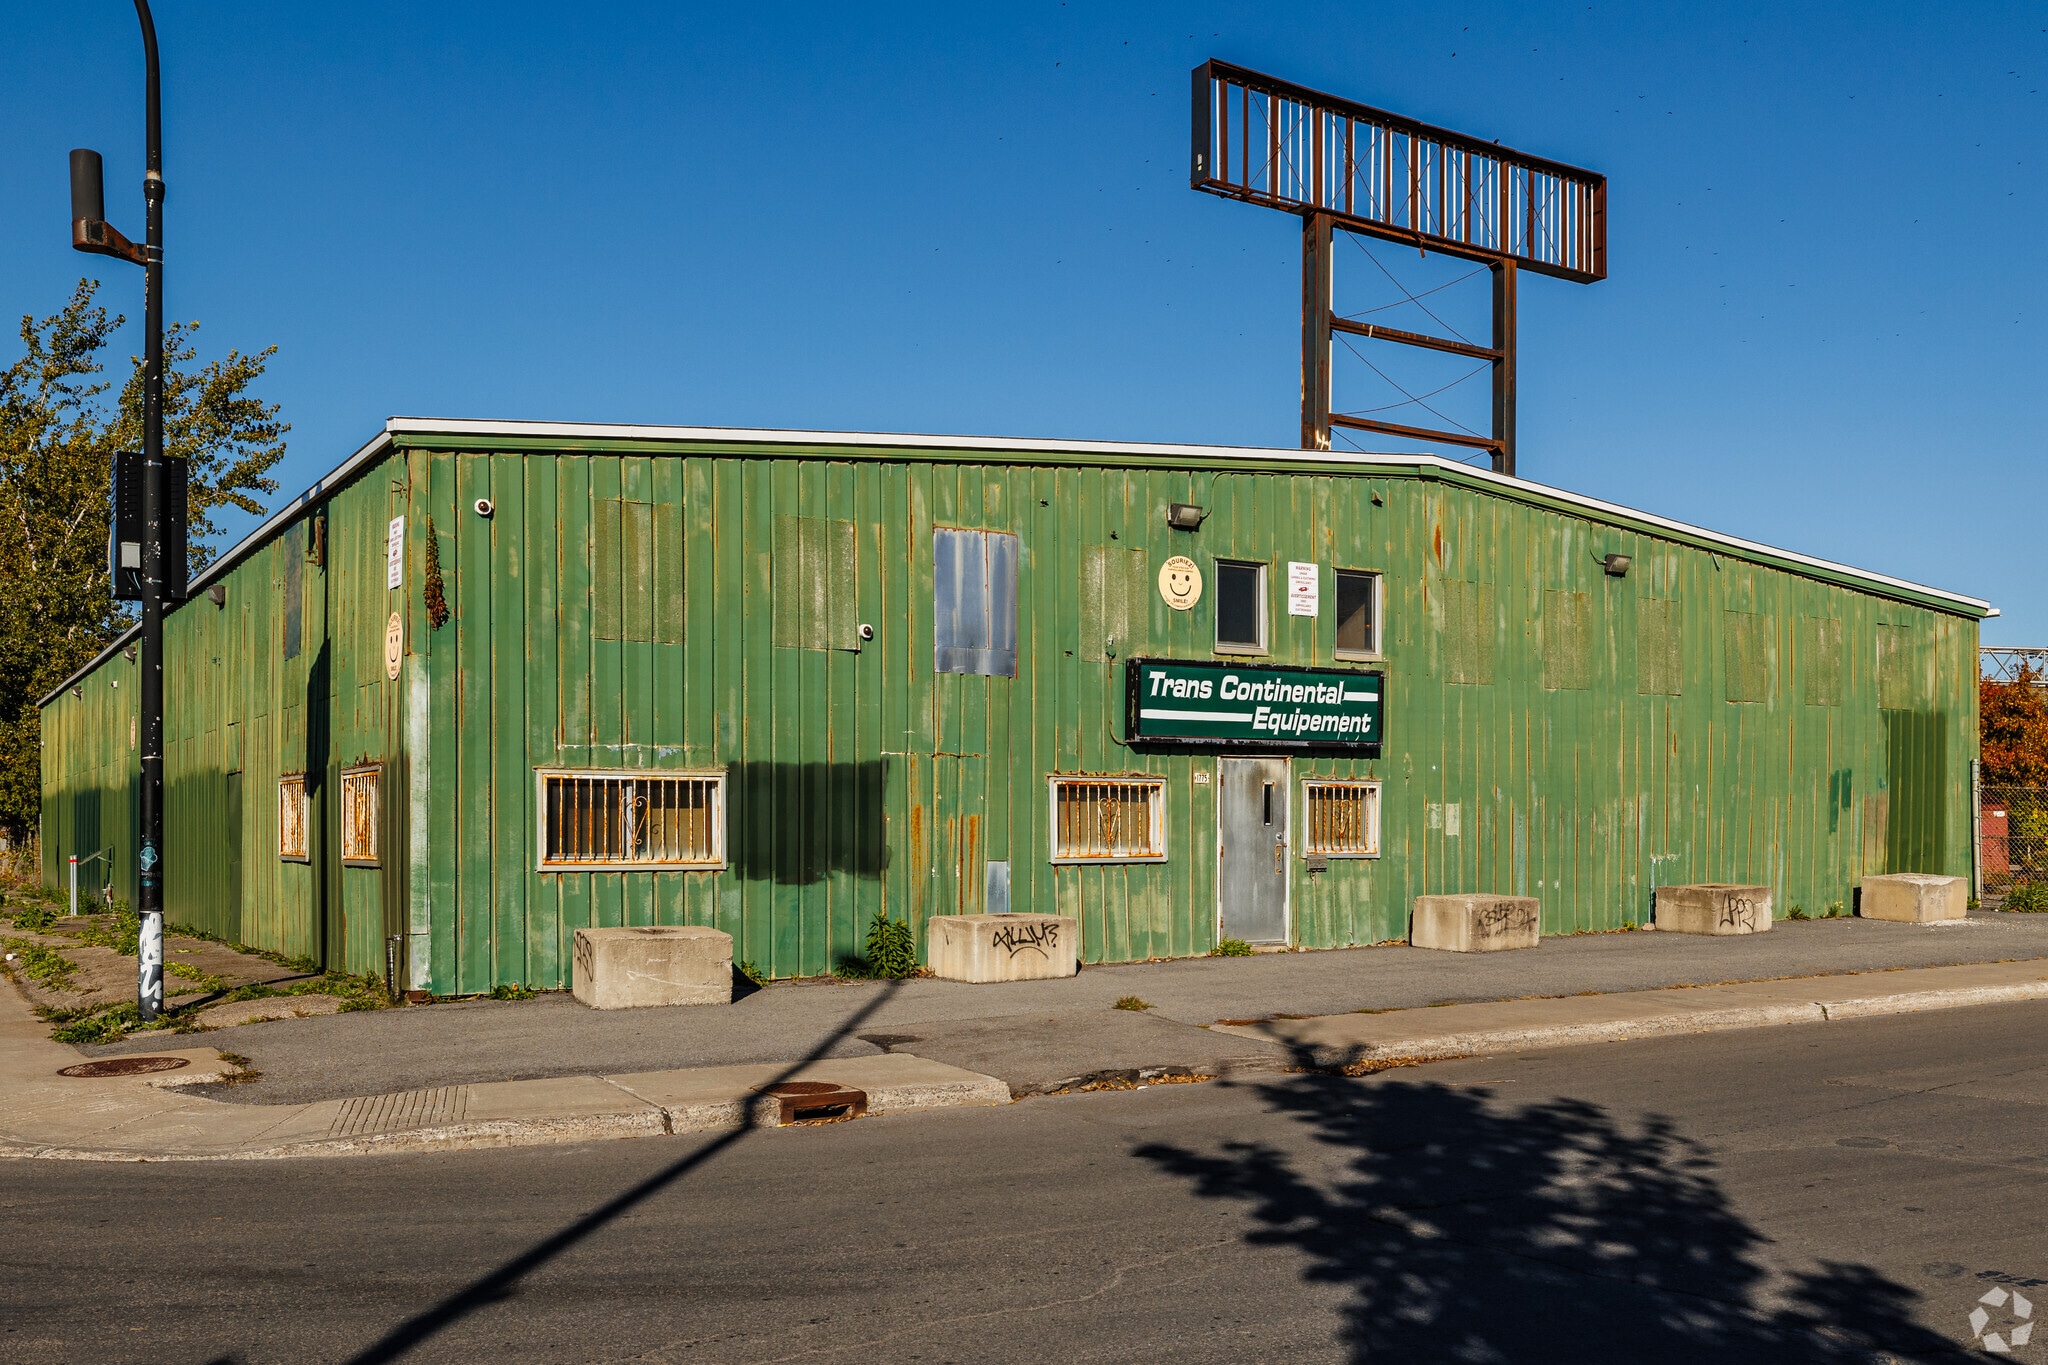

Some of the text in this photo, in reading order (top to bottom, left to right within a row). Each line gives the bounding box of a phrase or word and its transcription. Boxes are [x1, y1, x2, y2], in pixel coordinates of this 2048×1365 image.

[1148, 670, 1345, 705] Trans Continental
[1252, 706, 1372, 736] Equipement
